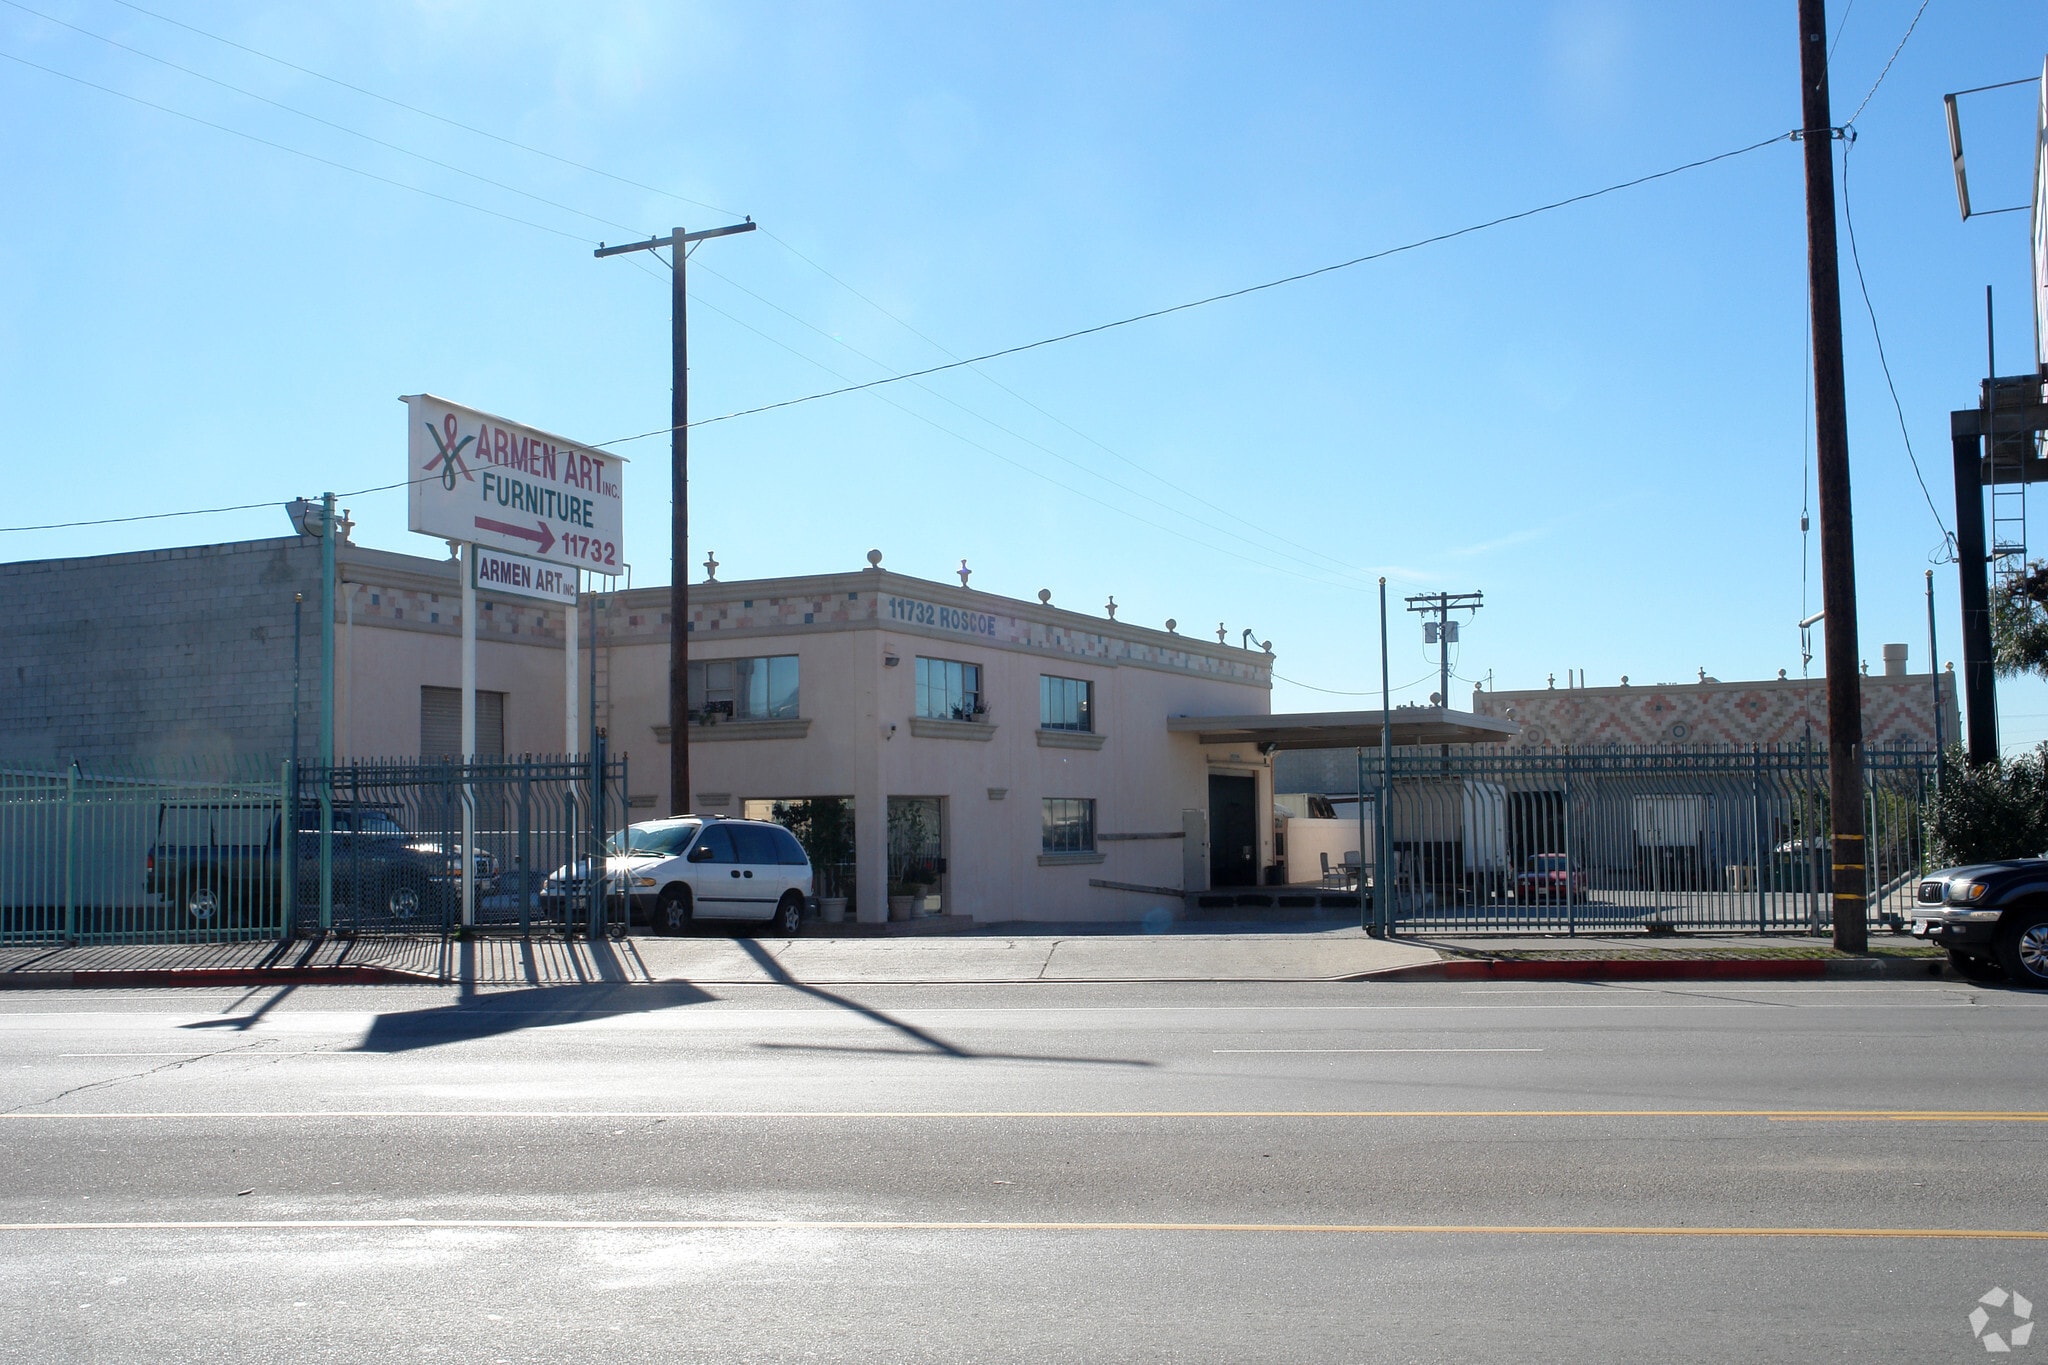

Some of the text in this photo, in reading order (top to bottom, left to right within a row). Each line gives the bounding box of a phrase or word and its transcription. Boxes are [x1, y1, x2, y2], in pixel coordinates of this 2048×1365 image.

[475, 424, 620, 499] ARMEN ART INC.
[483, 471, 594, 528] FURNITURE
[561, 532, 616, 566] 11732
[480, 557, 531, 588] ARMEN
[536, 569, 563, 594] ART
[889, 597, 996, 636] 11732 ROSCOE
